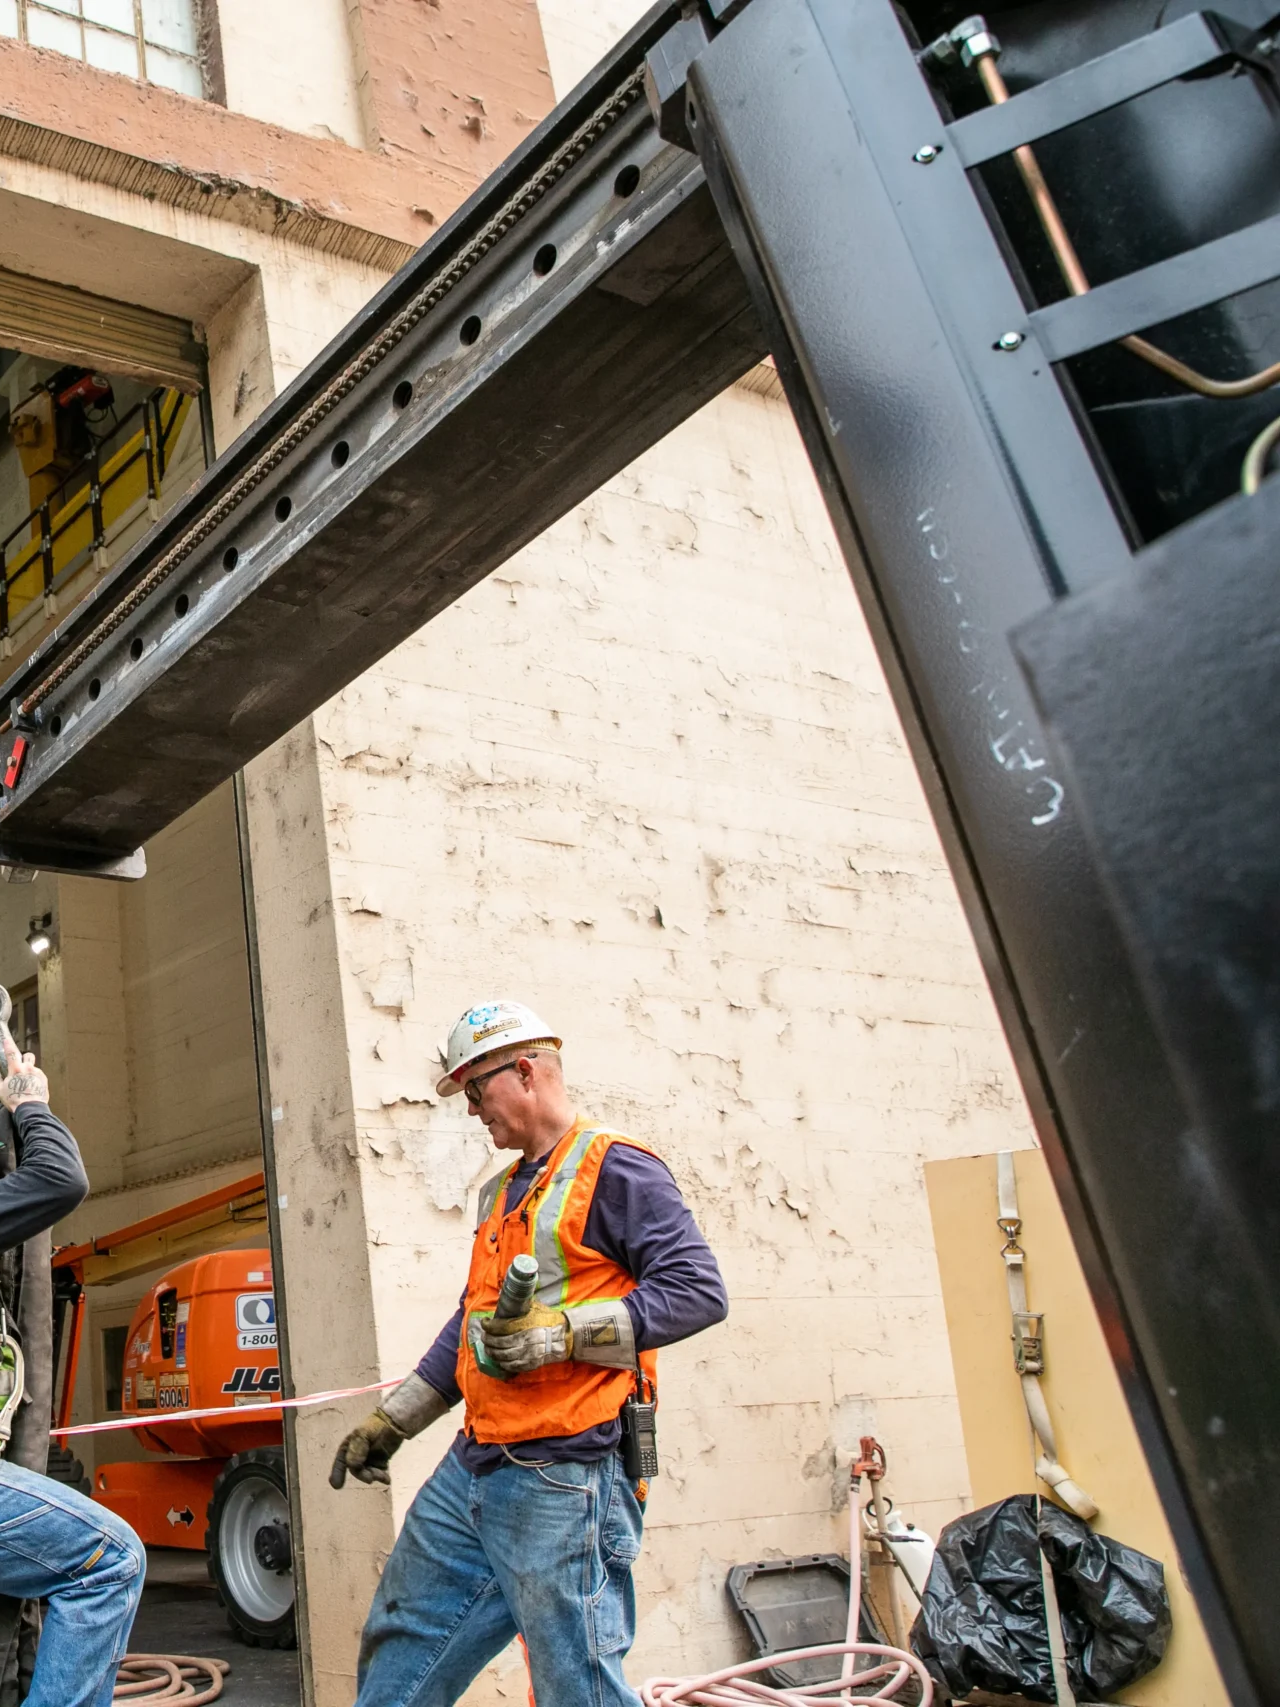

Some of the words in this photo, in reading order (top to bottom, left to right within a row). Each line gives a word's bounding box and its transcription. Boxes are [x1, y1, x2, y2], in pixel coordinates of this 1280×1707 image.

[241, 1334, 277, 1346] 1-800
[222, 1367, 280, 1392] JLG
[159, 1386, 189, 1408] 600AJ
